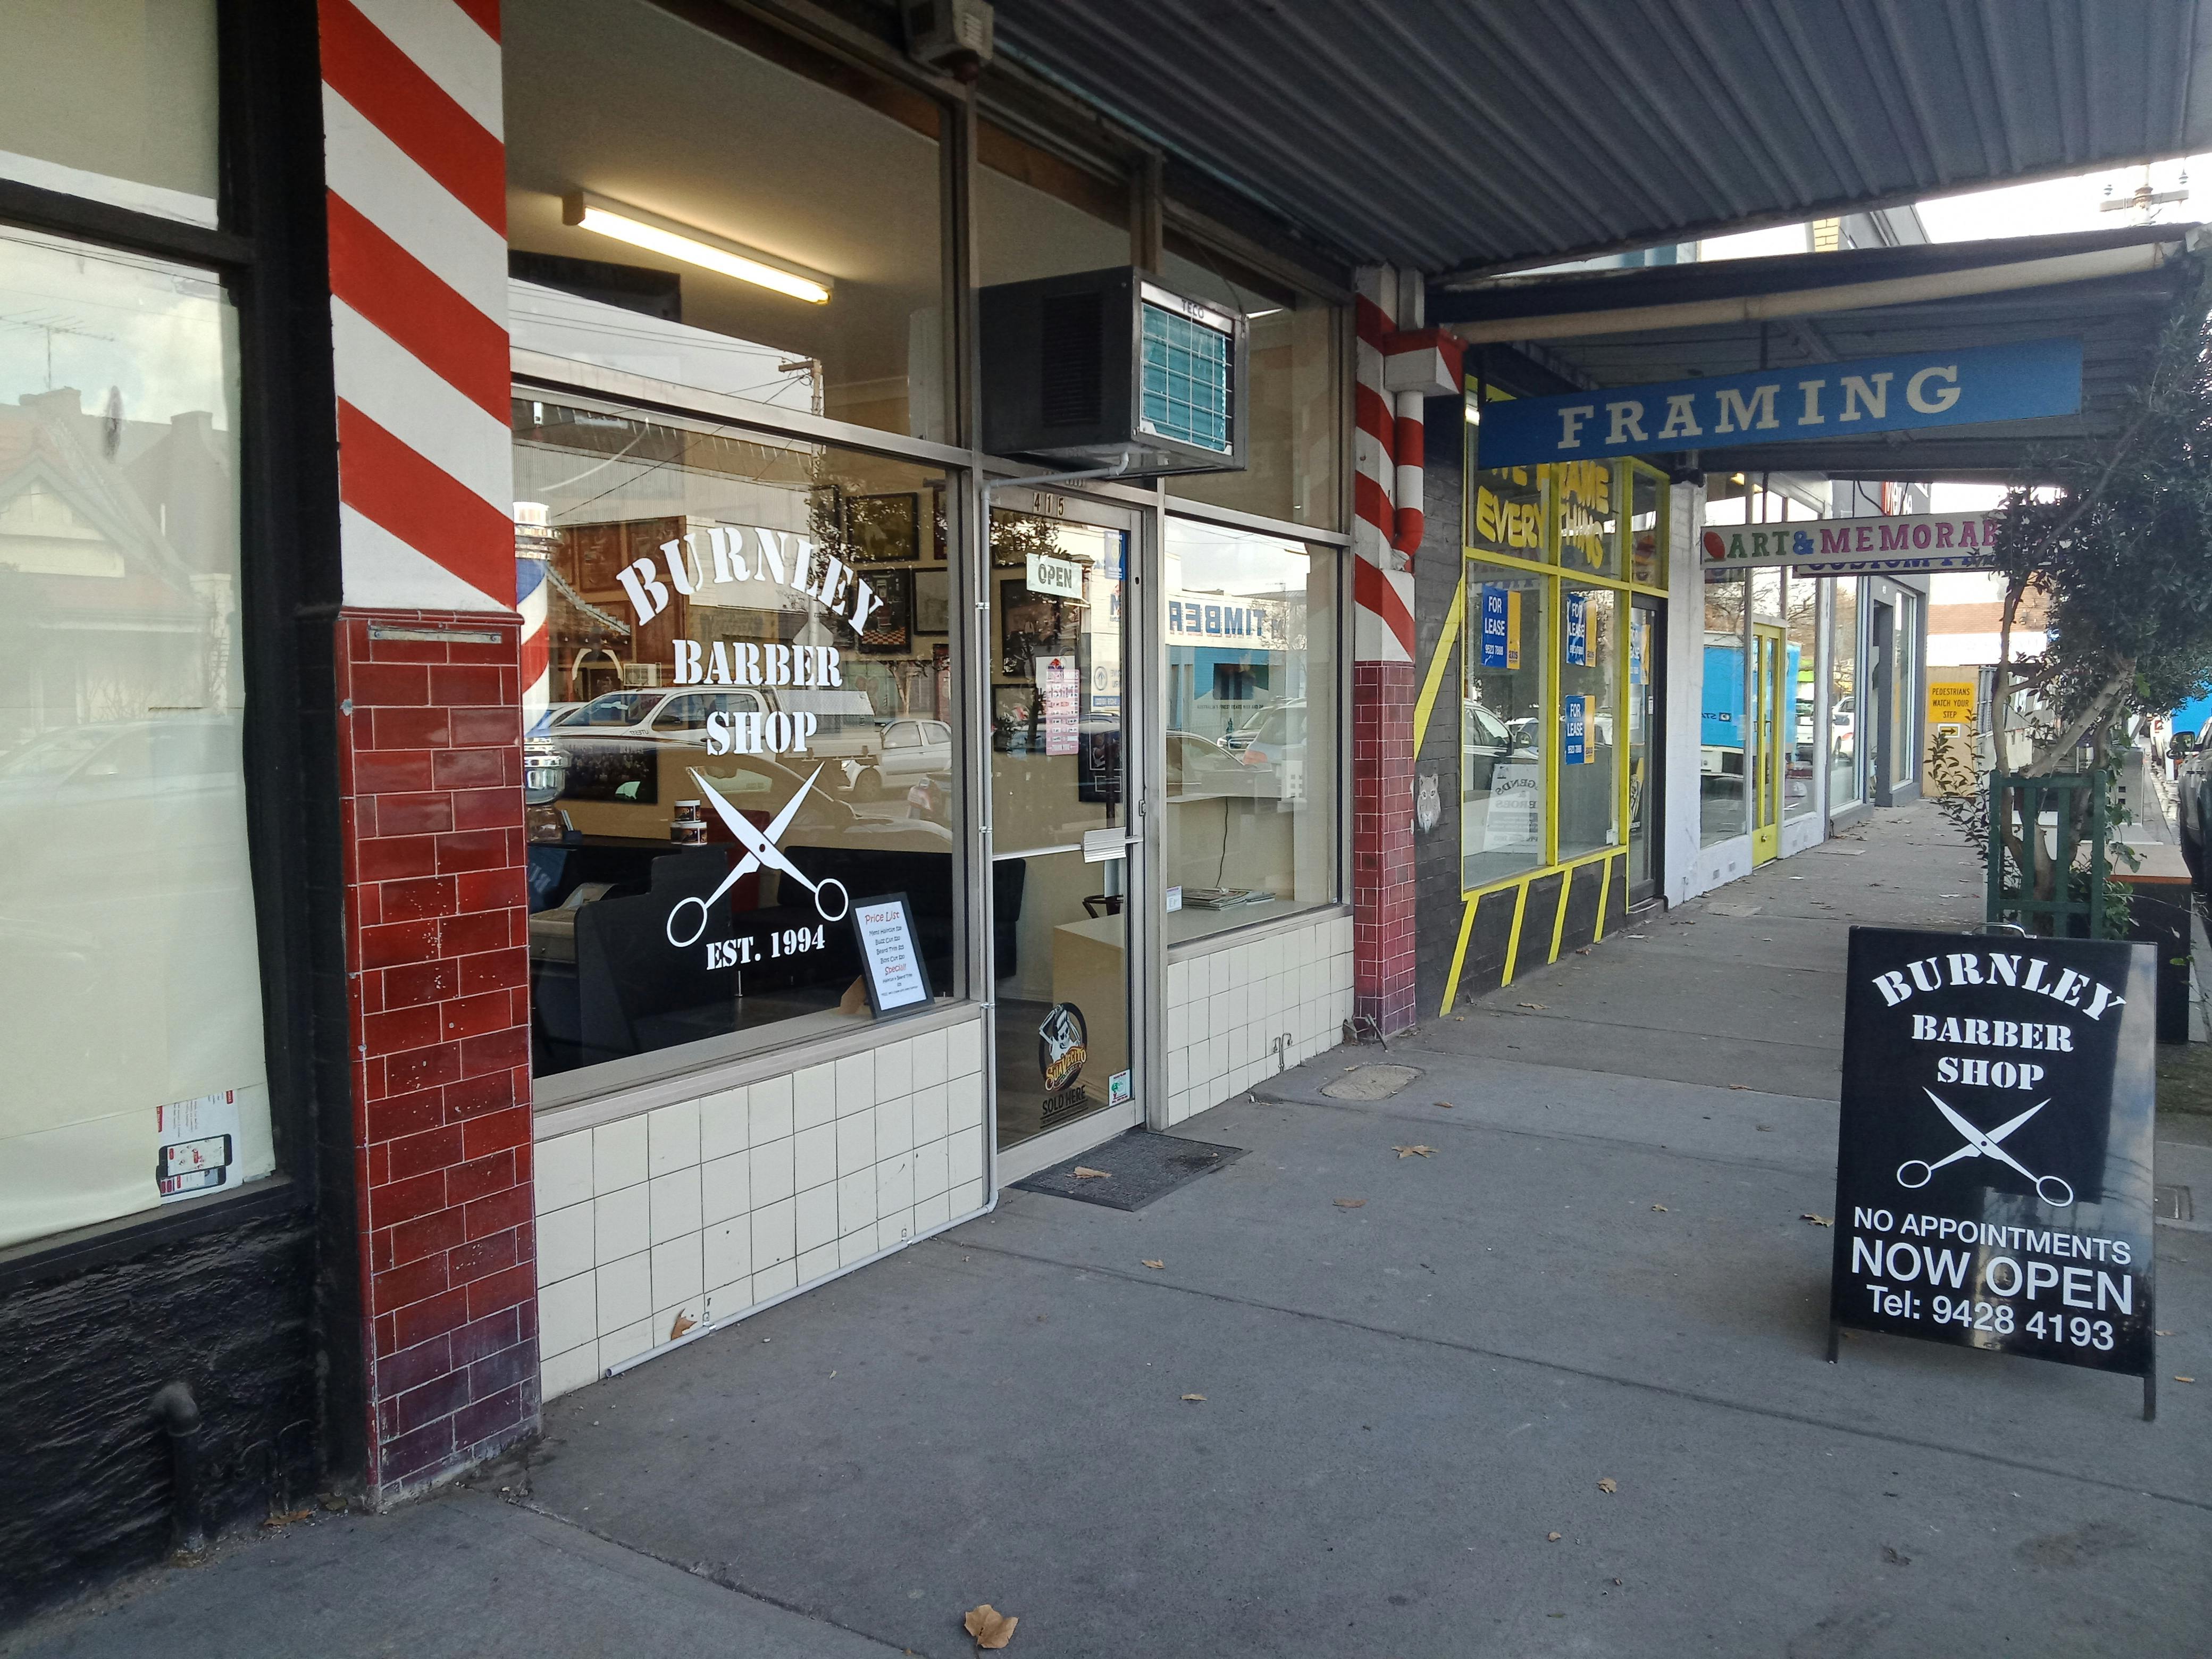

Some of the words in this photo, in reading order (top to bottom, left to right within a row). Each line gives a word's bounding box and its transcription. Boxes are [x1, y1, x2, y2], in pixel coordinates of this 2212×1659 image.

[1181, 299, 1204, 319] TECO
[1557, 365, 1961, 449] FRAMING
[1034, 493, 1064, 516] 415
[616, 526, 884, 636] BURNLEY
[1038, 564, 1072, 588] OPEN
[1488, 596, 1502, 613] FOR
[1572, 602, 1583, 618] FOR
[1485, 617, 1505, 636] LEASE
[1569, 622, 1585, 638] LEASE
[672, 639, 843, 688] BARBER
[1570, 703, 1580, 717] FOR
[707, 711, 817, 756] SHOP
[1567, 723, 1583, 736] LEASE
[865, 913, 884, 925] Price
[707, 937, 761, 970] EST.
[771, 925, 826, 958] 1994
[1872, 952, 2127, 1021] BURNLEY
[1911, 1015, 2074, 1053] BARBER
[1045, 1046, 1087, 1091] SUAVECITO
[1937, 1057, 2045, 1091] SHOP
[1042, 1093, 1063, 1115] SOLD
[1066, 1085, 1086, 1106] HERE
[1854, 1206, 1893, 1233] NO
[1900, 1213, 2132, 1265] APPOINTMENTS
[1852, 1237, 1971, 1289] NOW
[1987, 1256, 2133, 1315] OPEN
[1866, 1285, 1921, 1320] Tel:
[1932, 1296, 2015, 1335] 9428
[2026, 1314, 2115, 1351] 4193
